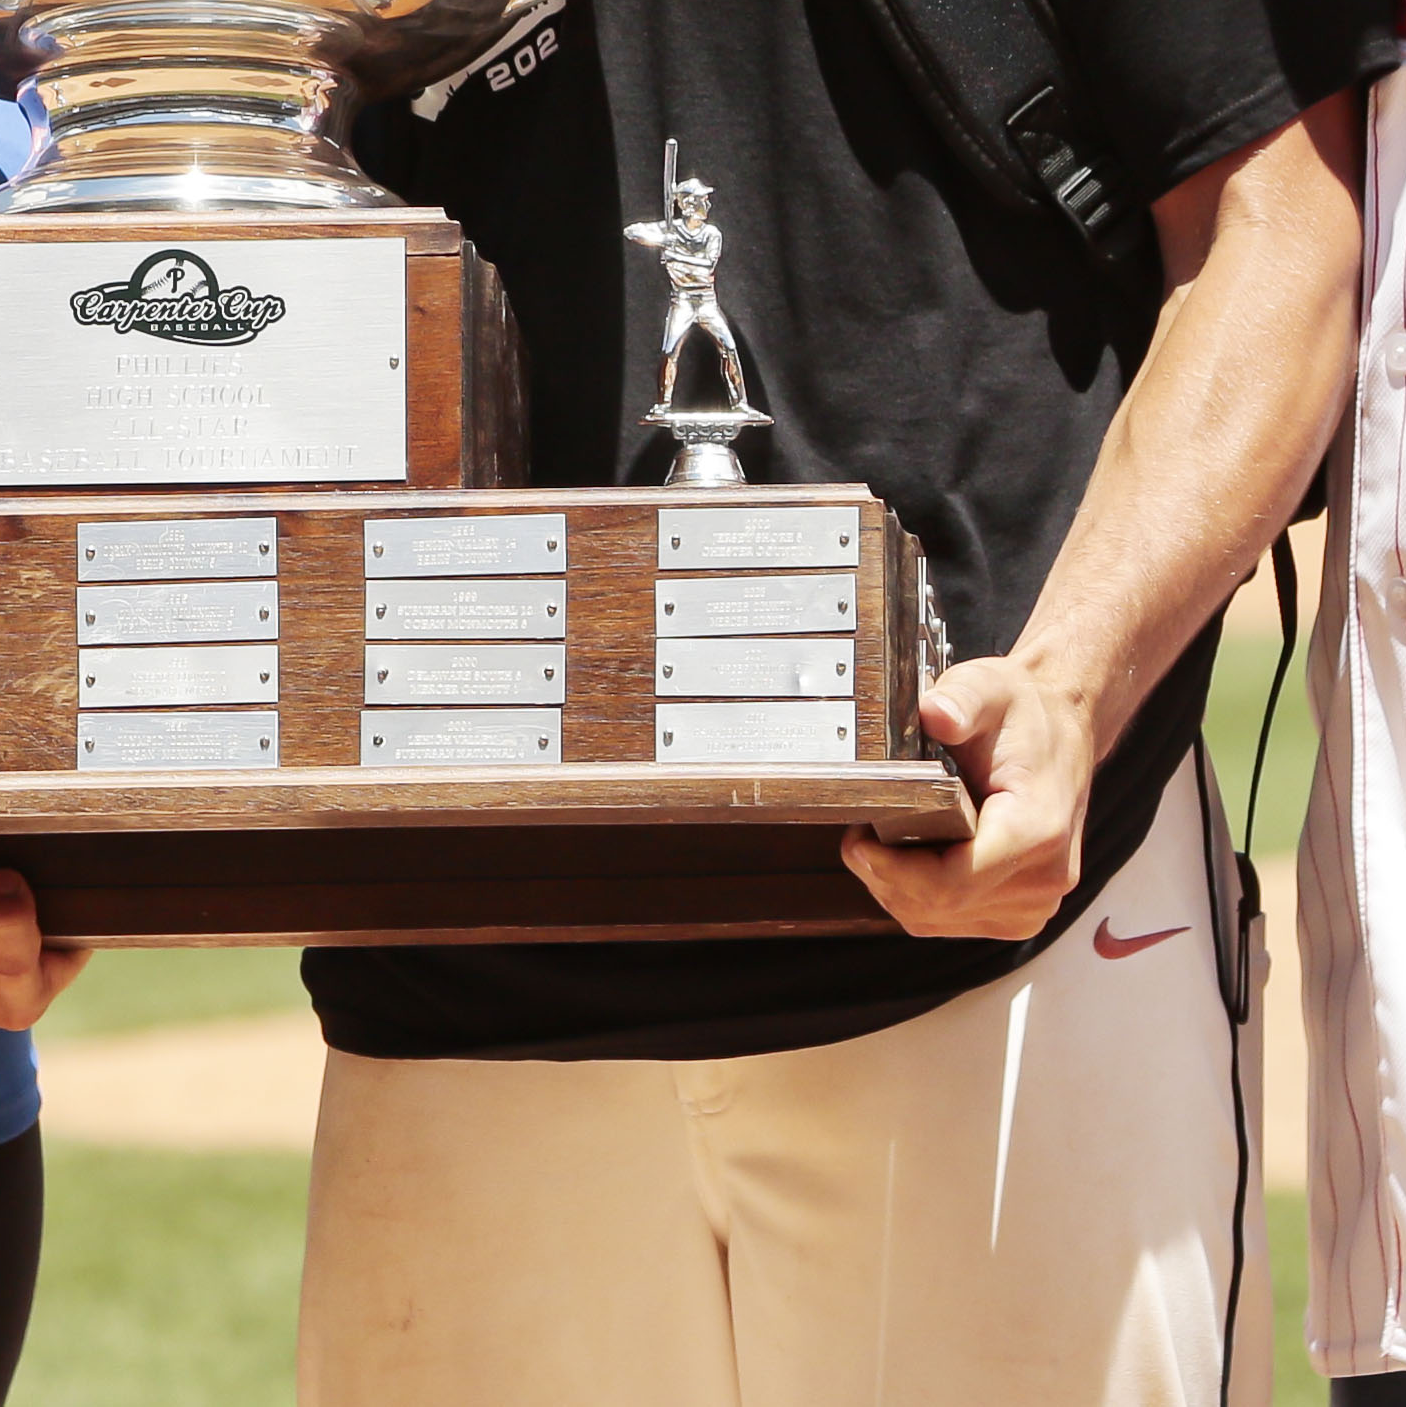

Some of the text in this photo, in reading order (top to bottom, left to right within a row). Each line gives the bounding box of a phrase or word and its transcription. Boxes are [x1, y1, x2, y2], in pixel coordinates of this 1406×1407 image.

[167, 267, 185, 293] P
[74, 288, 283, 332] Carpenter Cup
[149, 323, 246, 332] BASEBALL
[114, 352, 244, 378] PHILLIES
[84, 383, 273, 410] HIGH SCHOOL
[106, 416, 250, 441] ALL-STAR
[160, 444, 362, 472] TOURNAMENT
